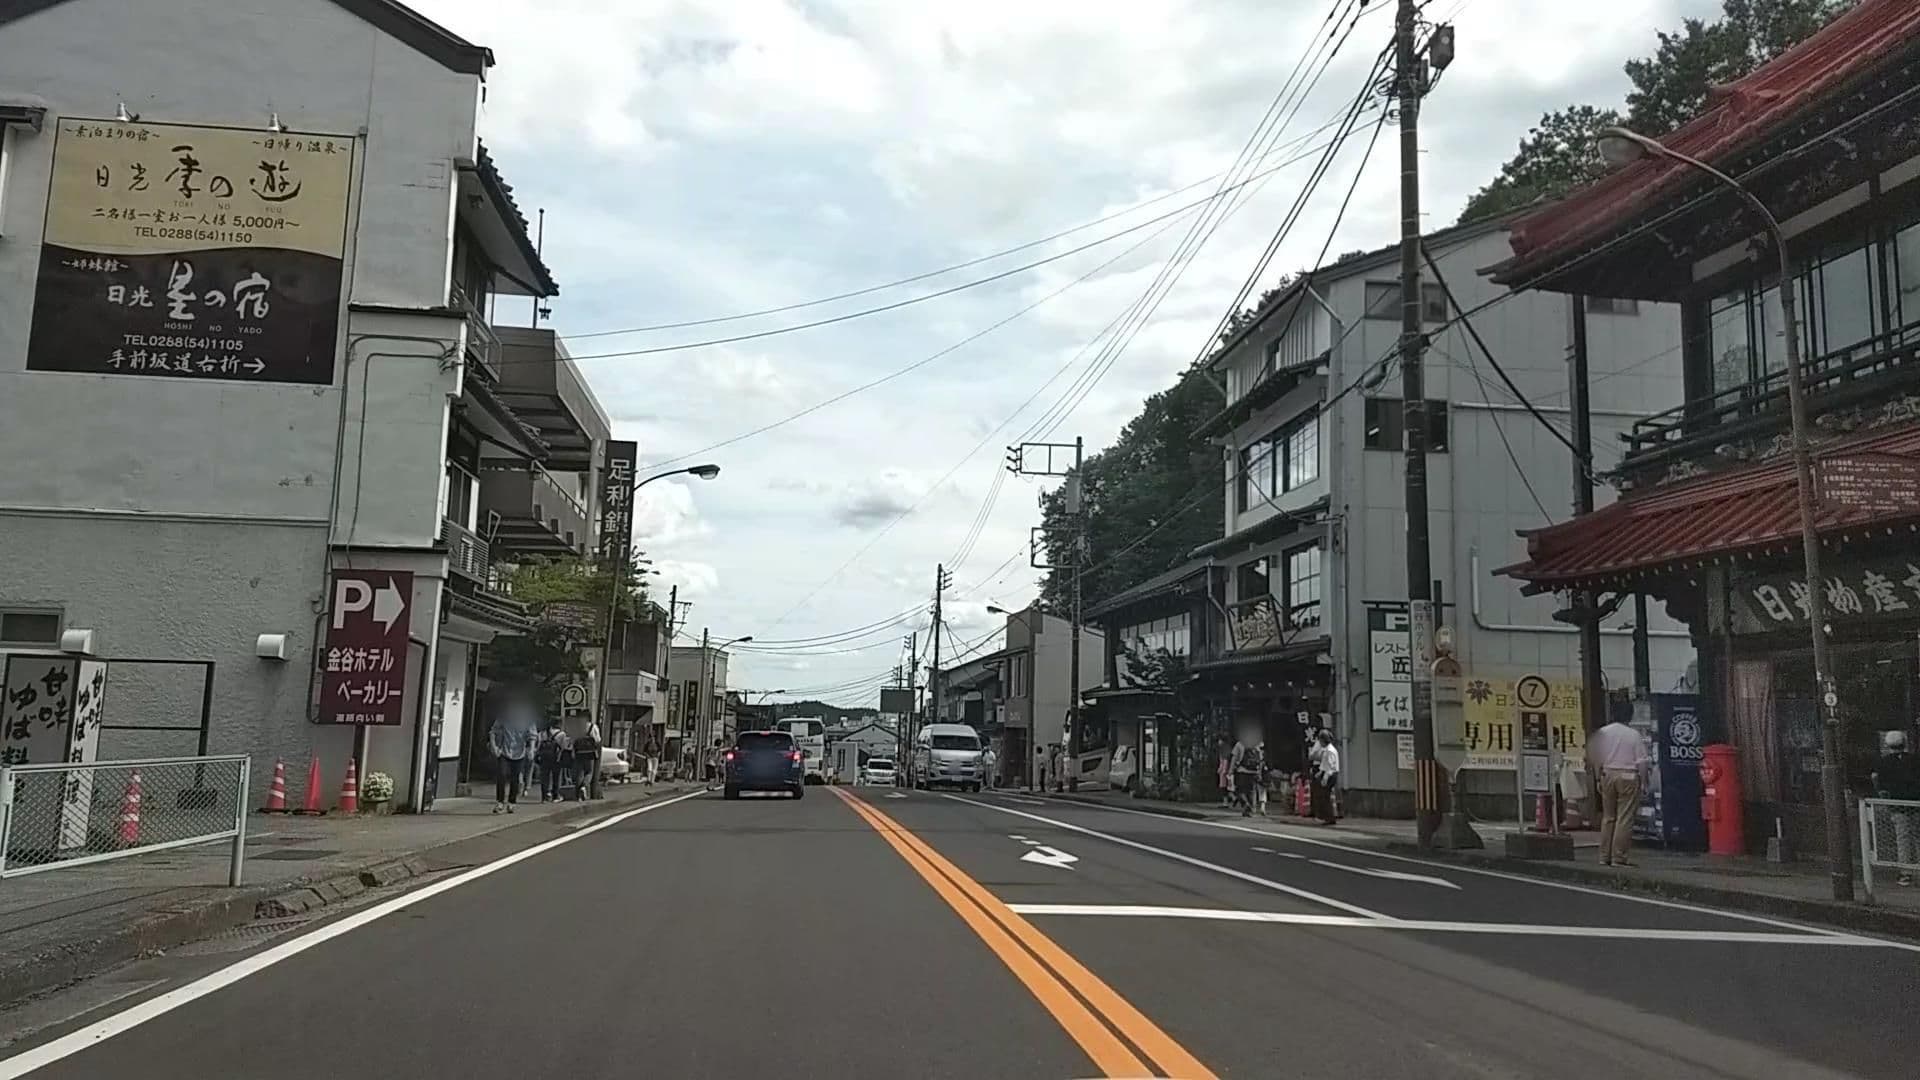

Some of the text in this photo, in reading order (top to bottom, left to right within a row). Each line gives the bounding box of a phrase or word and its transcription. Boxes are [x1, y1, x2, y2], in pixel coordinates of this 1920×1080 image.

[164, 322, 263, 334] HOSHI NO YADO
[106, 349, 240, 374] 手前坂道右折
[603, 458, 631, 558] 足利銀行
[333, 579, 372, 629] P
[1375, 643, 1410, 654] レスト
[327, 647, 394, 672] 金谷ホテル
[337, 680, 401, 704] ベーカリー
[570, 690, 578, 700] 7
[1528, 683, 1539, 697] 7
[1376, 695, 1409, 712] そば
[1670, 745, 1704, 759] BOSS
